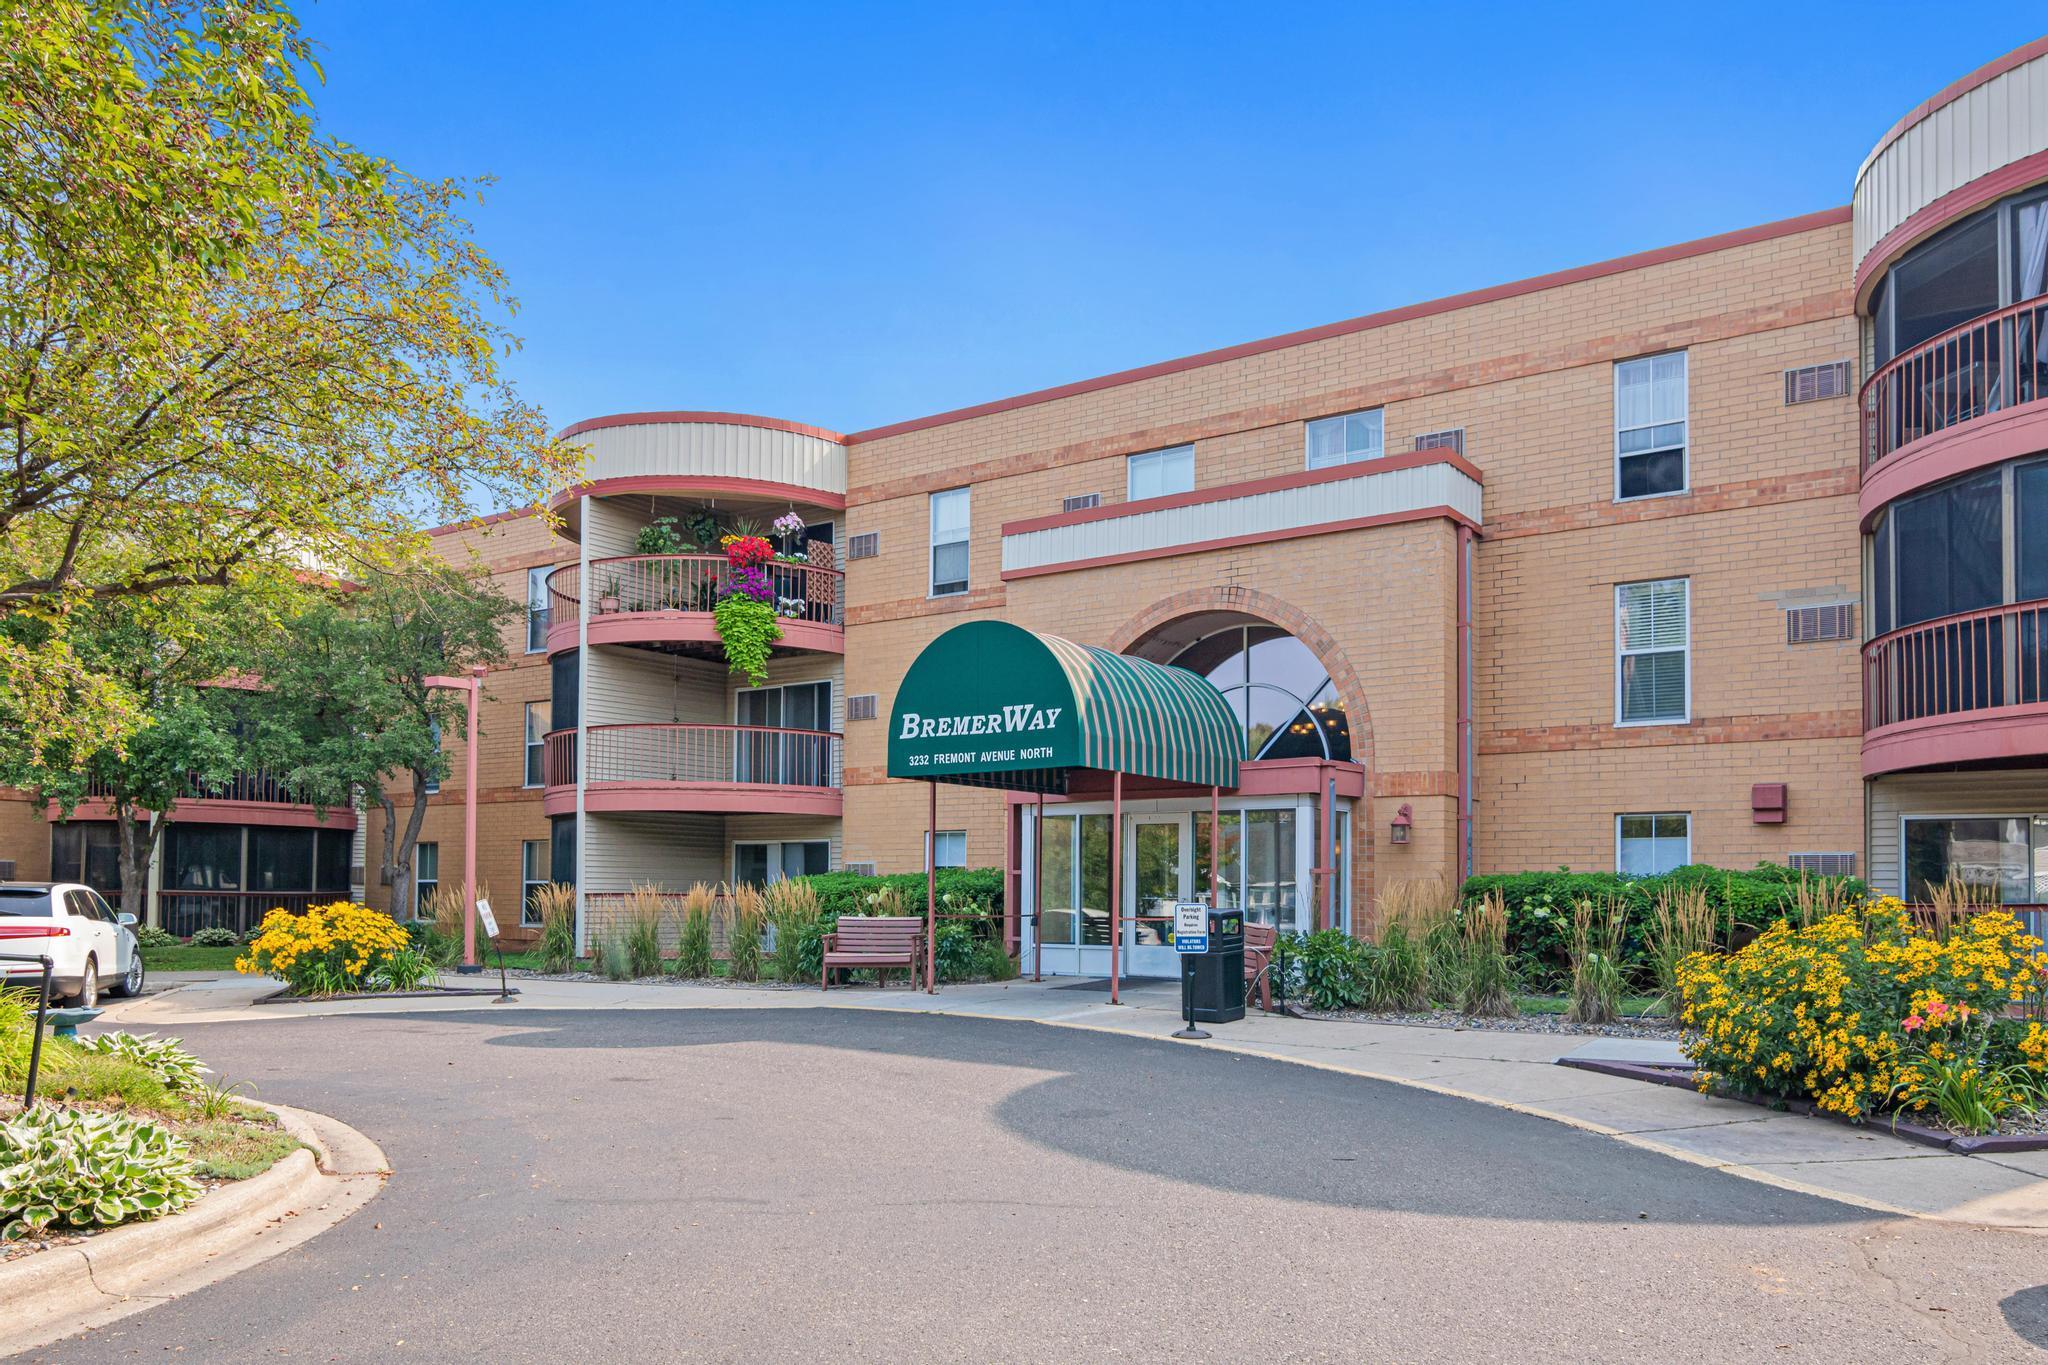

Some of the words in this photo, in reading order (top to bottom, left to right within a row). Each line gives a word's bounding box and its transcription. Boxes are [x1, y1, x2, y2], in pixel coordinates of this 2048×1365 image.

[909, 754, 929, 767] 3232
[934, 752, 976, 765] FREMONT
[980, 749, 1015, 762] AVENUE
[1020, 746, 1053, 759] NORTH
